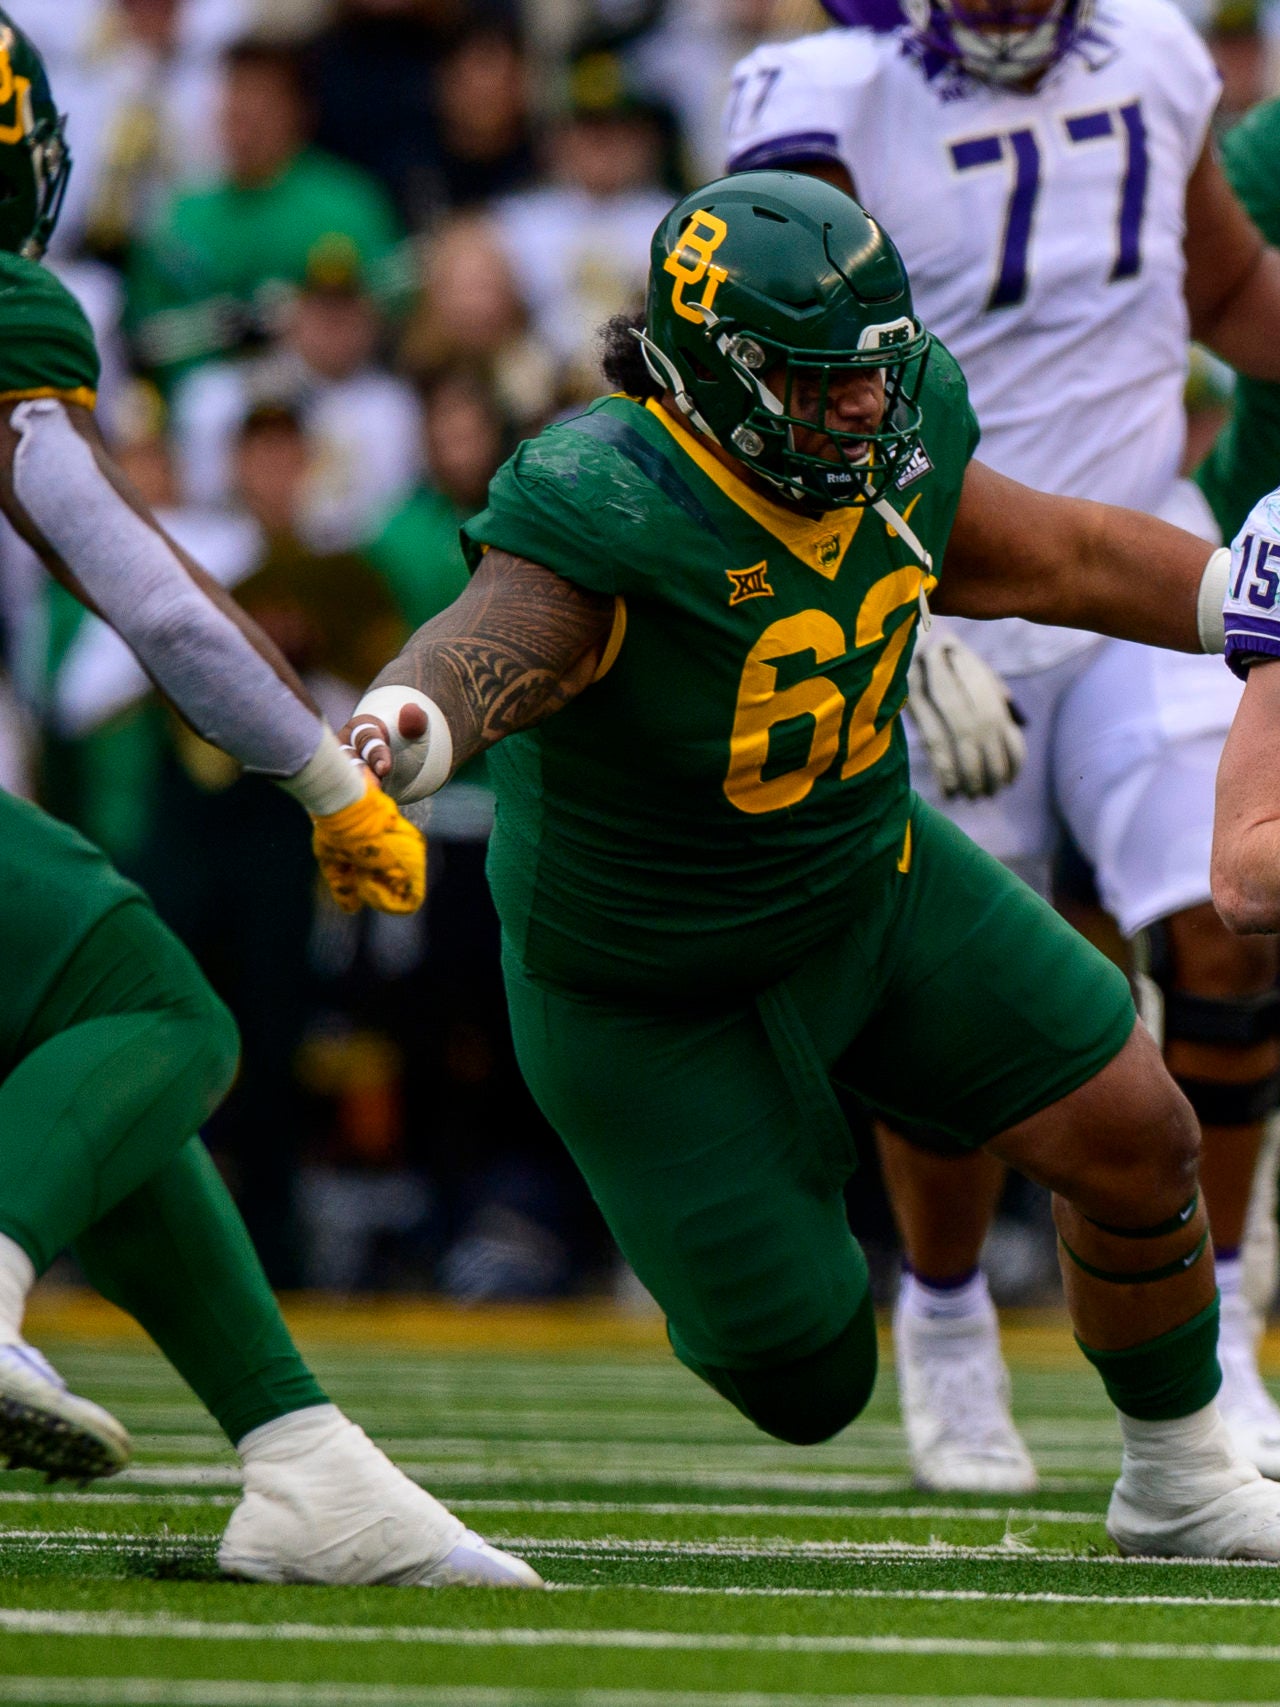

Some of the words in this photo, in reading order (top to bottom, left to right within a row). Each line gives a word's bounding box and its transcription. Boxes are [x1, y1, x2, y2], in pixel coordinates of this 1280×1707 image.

[664, 209, 728, 324] BU
[948, 98, 1151, 312] 77
[723, 565, 938, 814] 62
